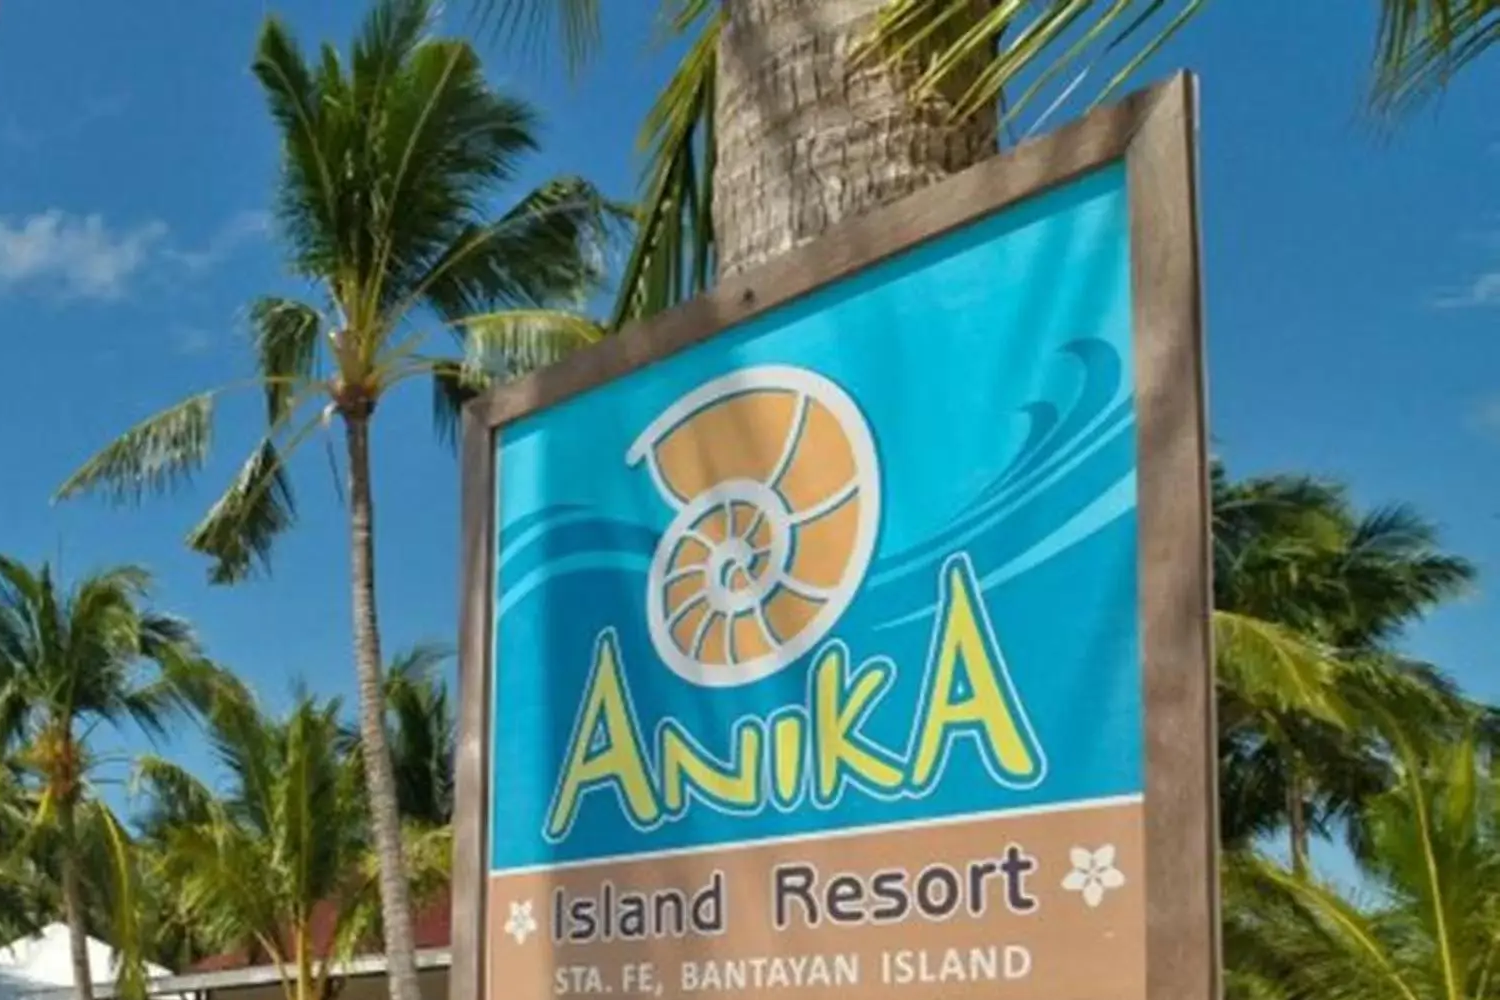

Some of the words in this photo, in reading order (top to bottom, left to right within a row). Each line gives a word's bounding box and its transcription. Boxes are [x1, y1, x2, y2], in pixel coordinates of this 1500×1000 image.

[552, 870, 728, 945] Island
[772, 842, 1038, 931] Resort
[553, 965, 613, 995] STA.
[621, 962, 664, 997] FE,
[680, 953, 859, 991] BANTAYAN
[881, 944, 1033, 985] ISLAND
